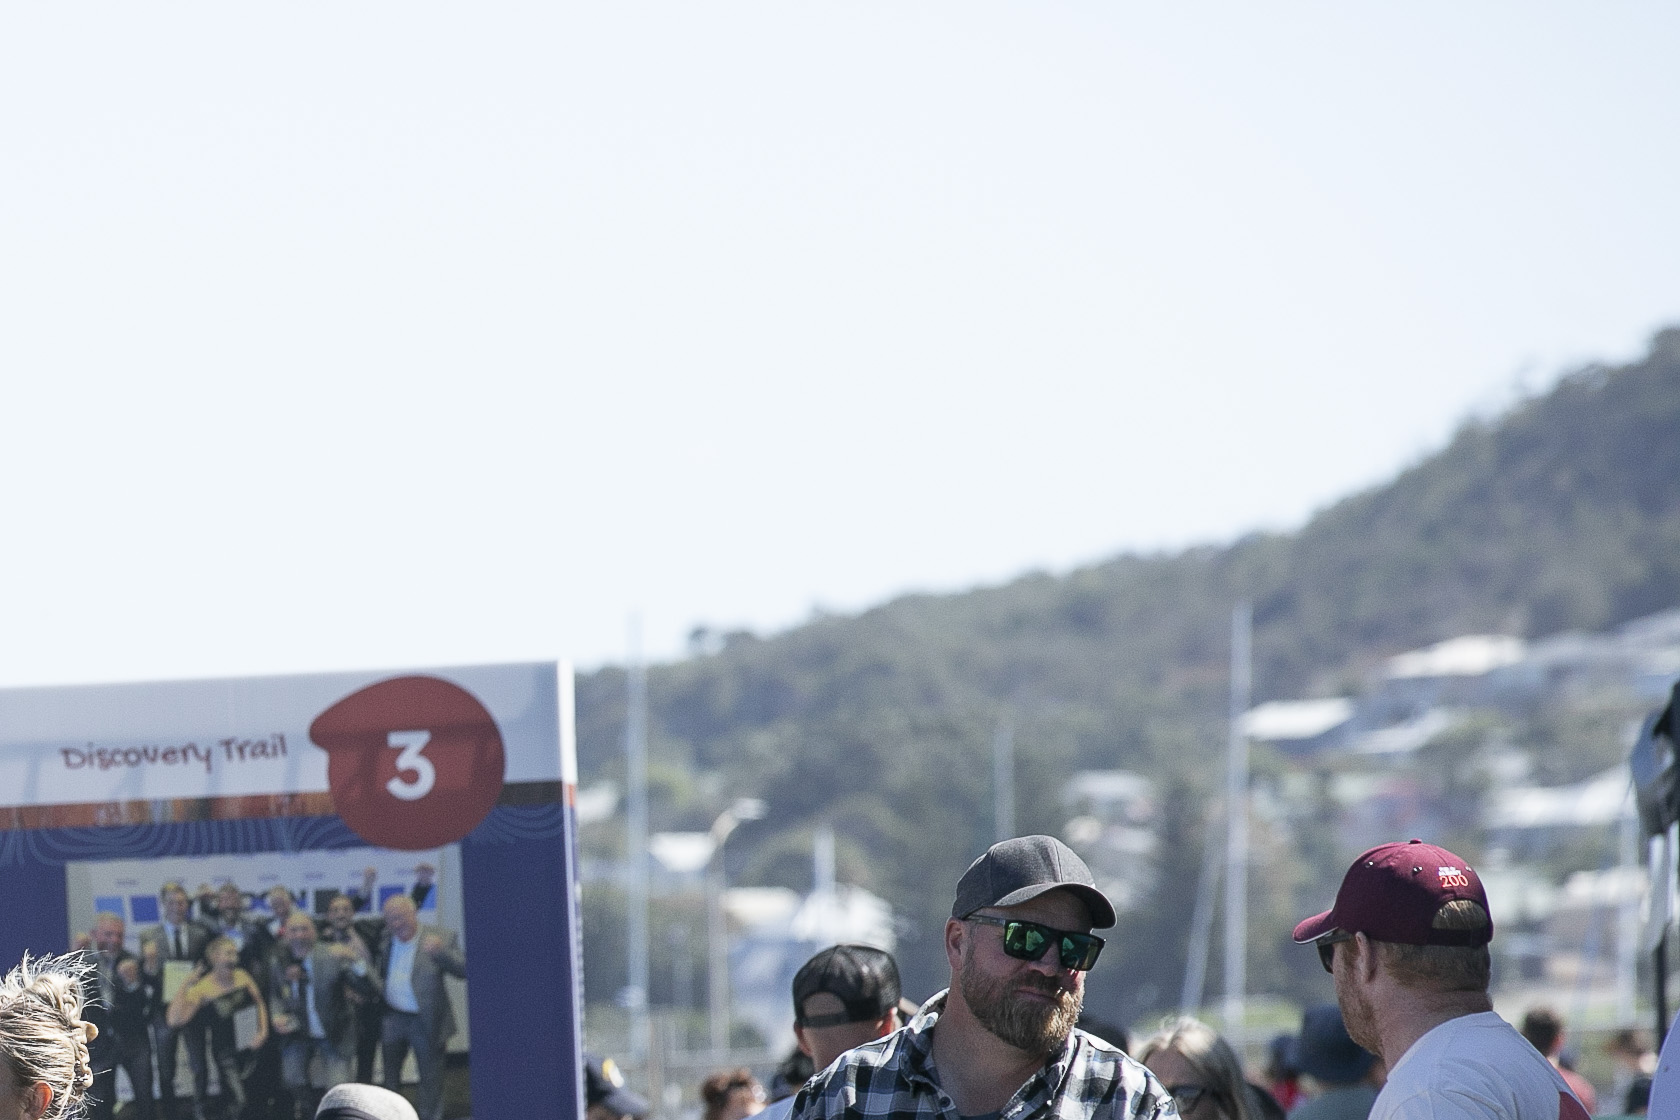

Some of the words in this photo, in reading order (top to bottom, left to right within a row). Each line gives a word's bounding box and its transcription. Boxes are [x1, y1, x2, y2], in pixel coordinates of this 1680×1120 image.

[60, 744, 212, 773] Discovery
[220, 734, 287, 763] Trail
[387, 730, 436, 800] 3
[1439, 874, 1469, 888] 200
